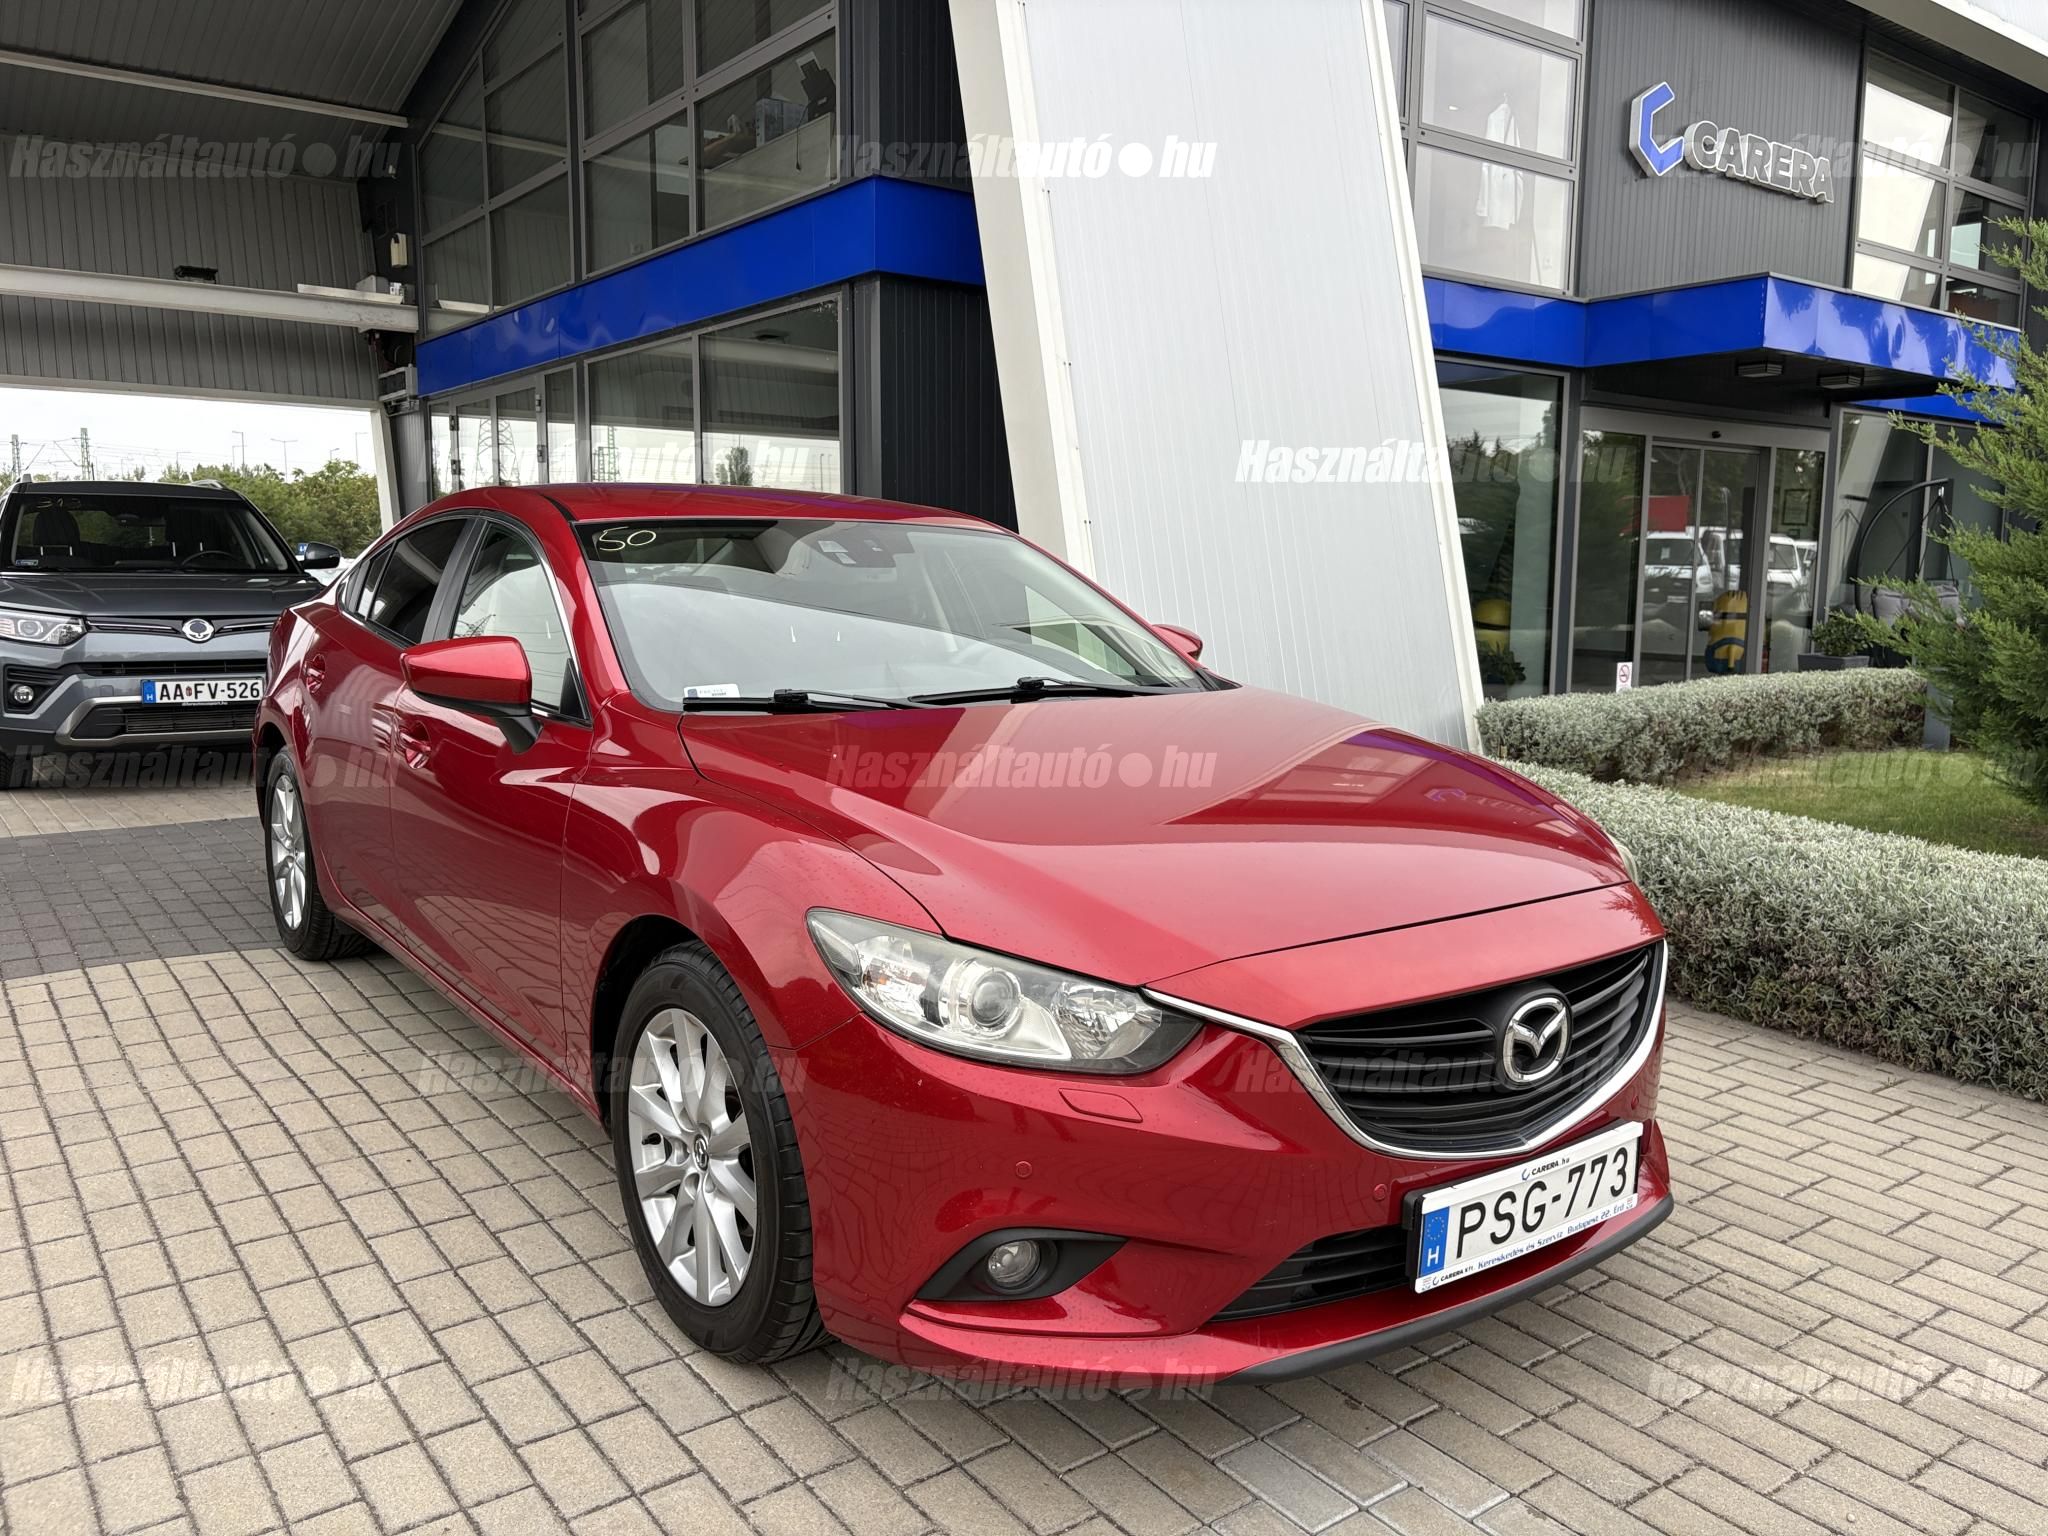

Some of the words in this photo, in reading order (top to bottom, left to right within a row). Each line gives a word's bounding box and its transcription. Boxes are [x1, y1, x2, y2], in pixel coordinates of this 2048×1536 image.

[1684, 120, 1834, 204] CARERA
[598, 526, 656, 551] 50
[1456, 1147, 1628, 1259] PSG-773
[1427, 1245, 1439, 1267] H
